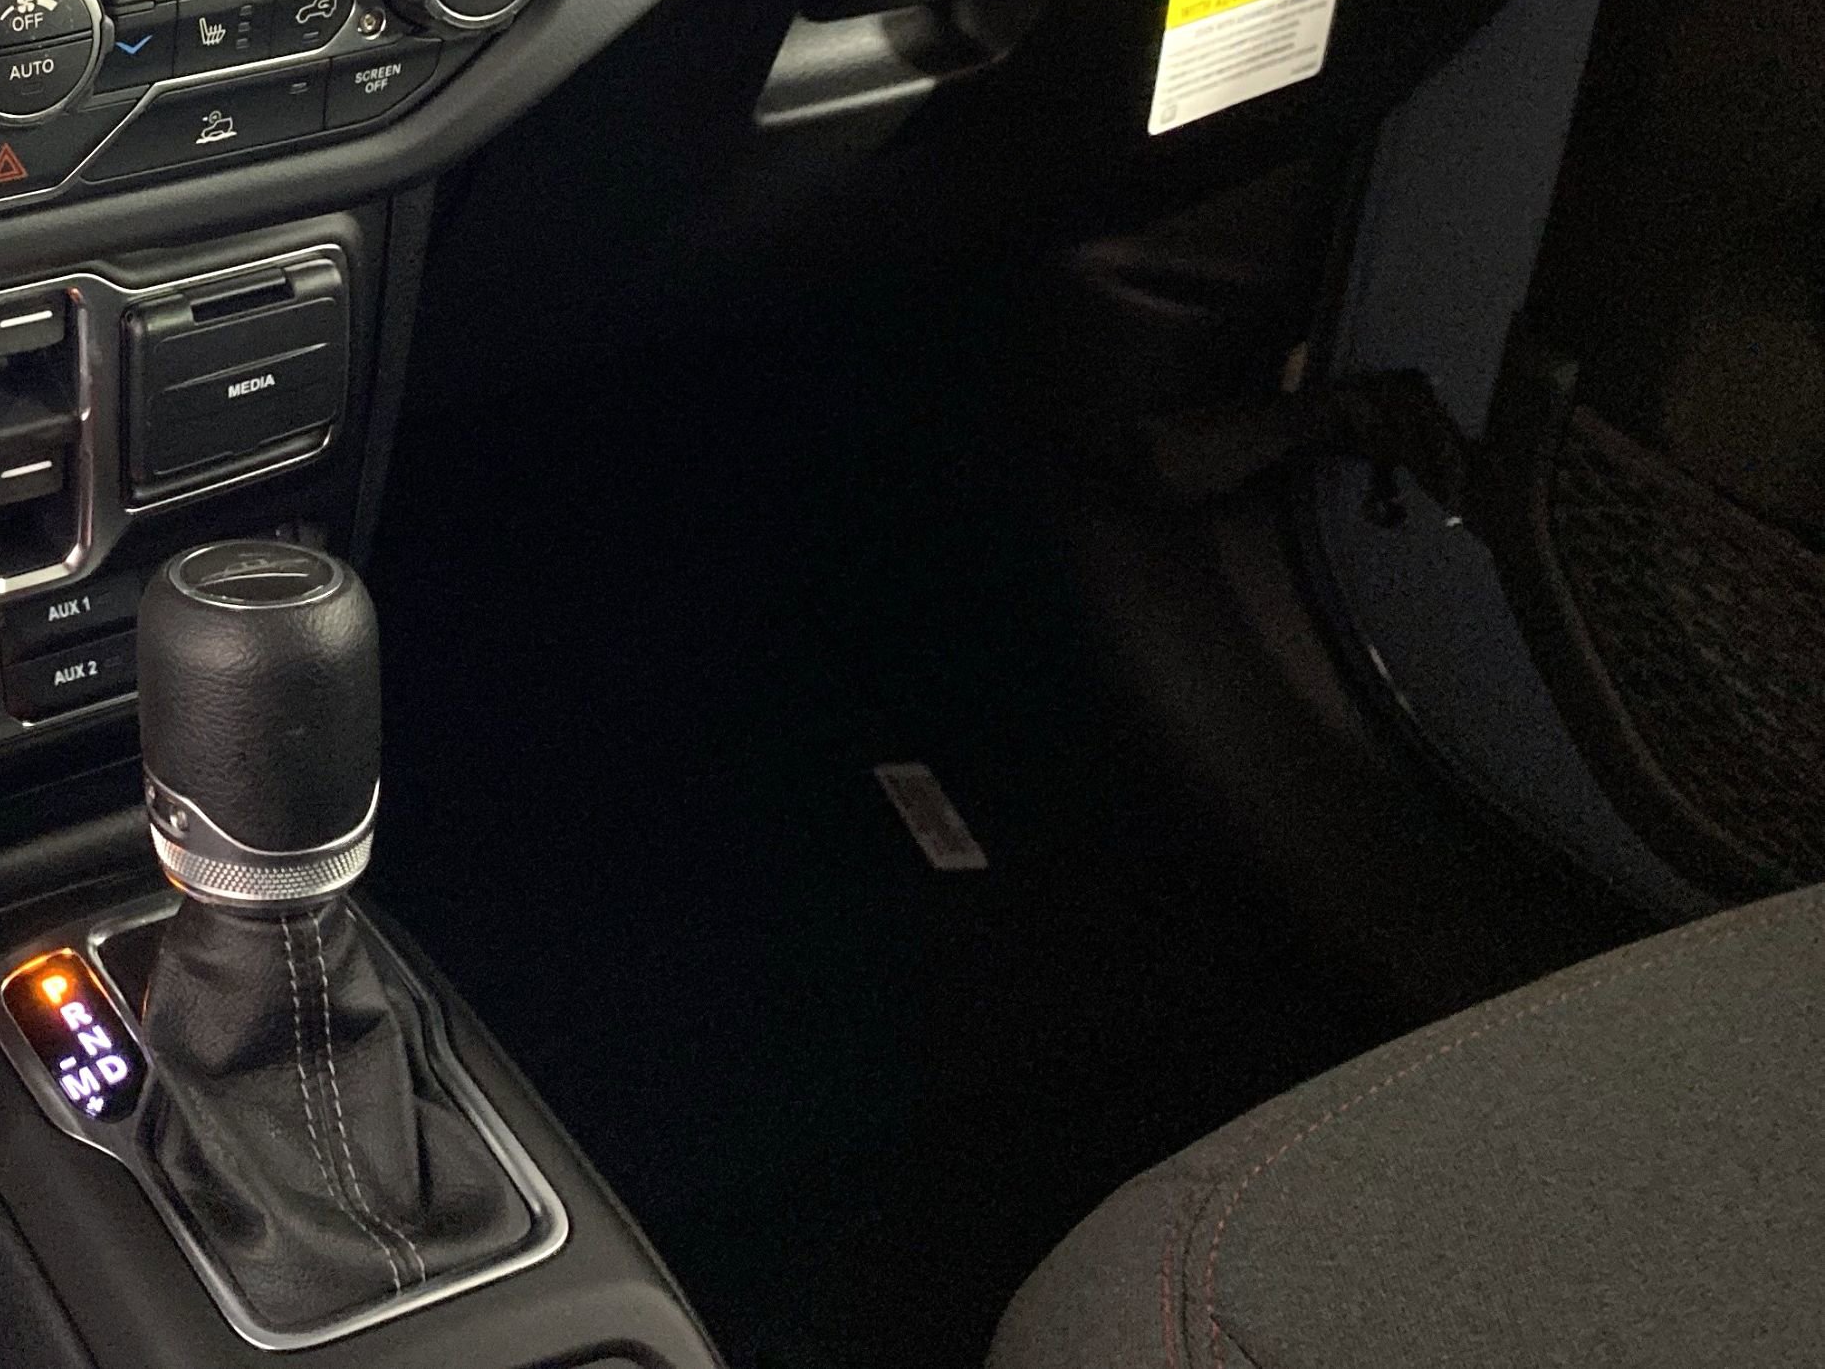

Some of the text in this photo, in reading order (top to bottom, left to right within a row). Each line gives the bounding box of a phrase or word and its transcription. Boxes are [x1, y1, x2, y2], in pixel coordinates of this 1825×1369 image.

[10, 11, 44, 33] OFF
[8, 57, 55, 83] AUTO
[354, 62, 402, 84] SCREEN
[364, 77, 389, 94] OFF
[227, 373, 276, 399] MEDIA
[48, 595, 91, 622] AUX 1
[54, 660, 99, 686] AUX 2
[41, 974, 68, 1005] P
[59, 1001, 93, 1031] R
[77, 1024, 113, 1056] N
[95, 1054, 129, 1085] D
[60, 1065, 101, 1101] M
